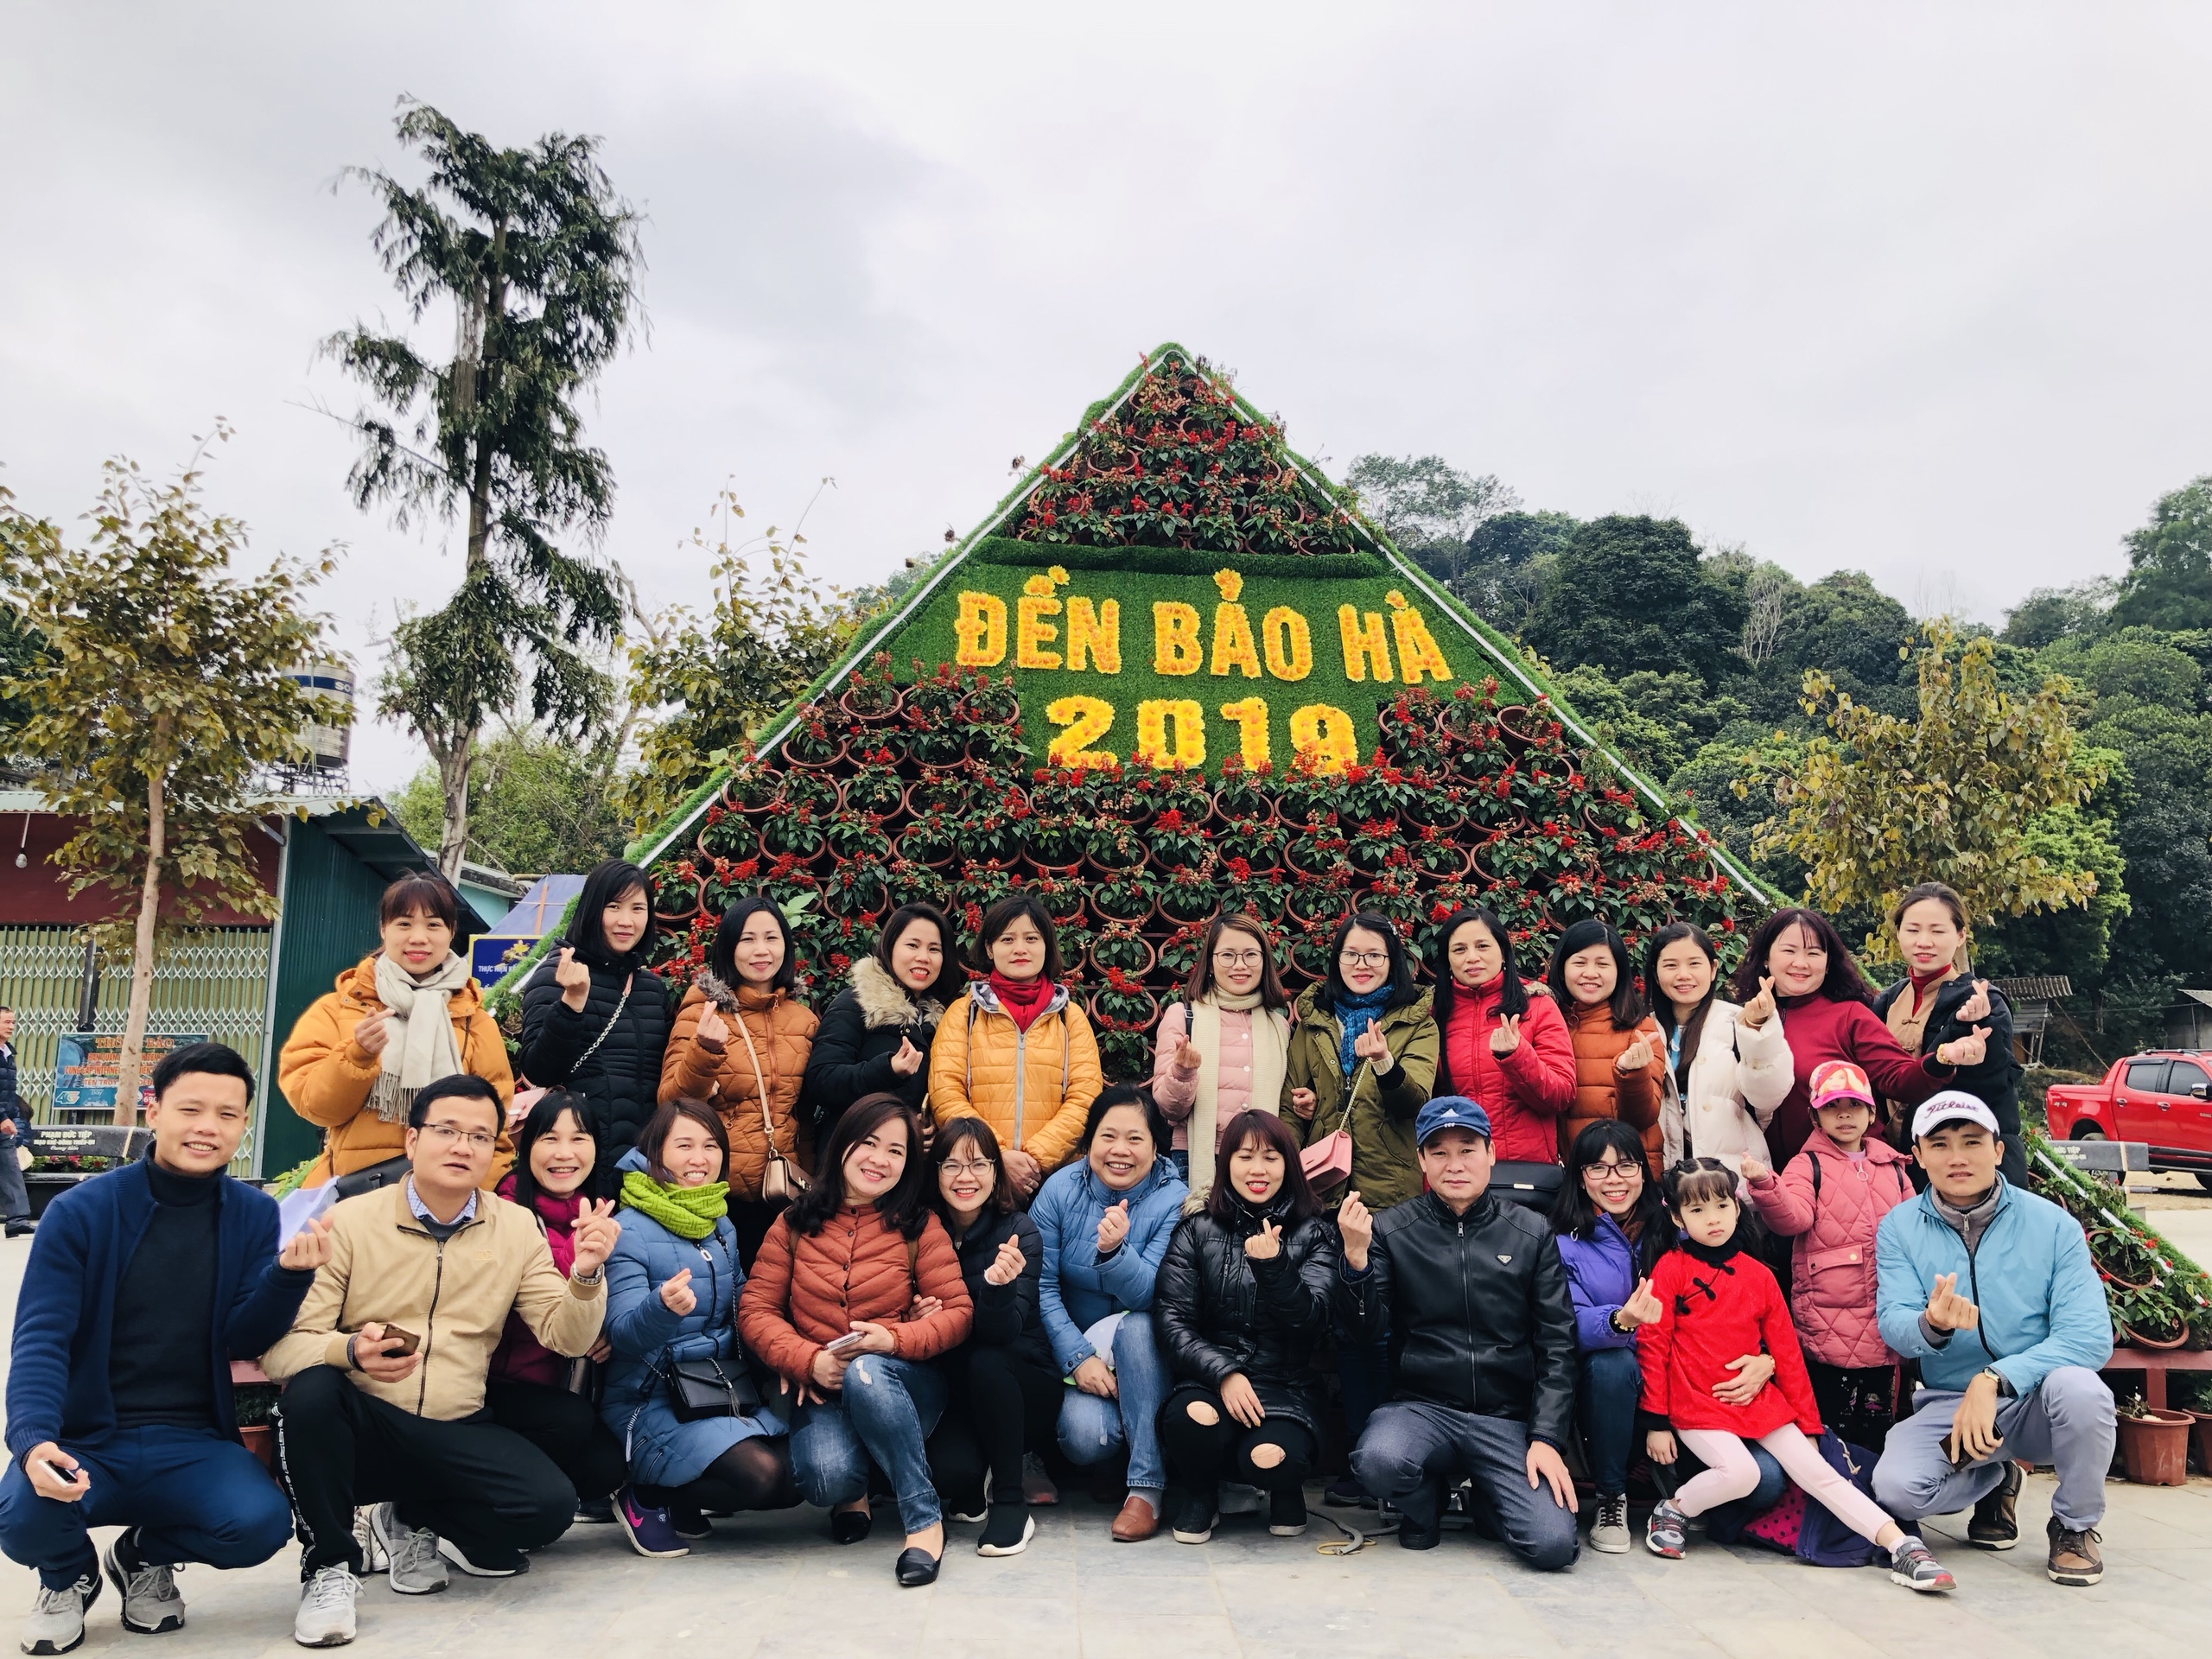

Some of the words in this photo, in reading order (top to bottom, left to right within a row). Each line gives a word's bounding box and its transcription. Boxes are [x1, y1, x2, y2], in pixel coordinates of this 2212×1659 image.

[1153, 568, 1313, 681] BẢO
[1338, 589, 1453, 684] HÀ
[1046, 696, 1357, 777] 2019
[478, 965, 493, 974] THỰC
[55, 1090, 80, 1104] 4G
